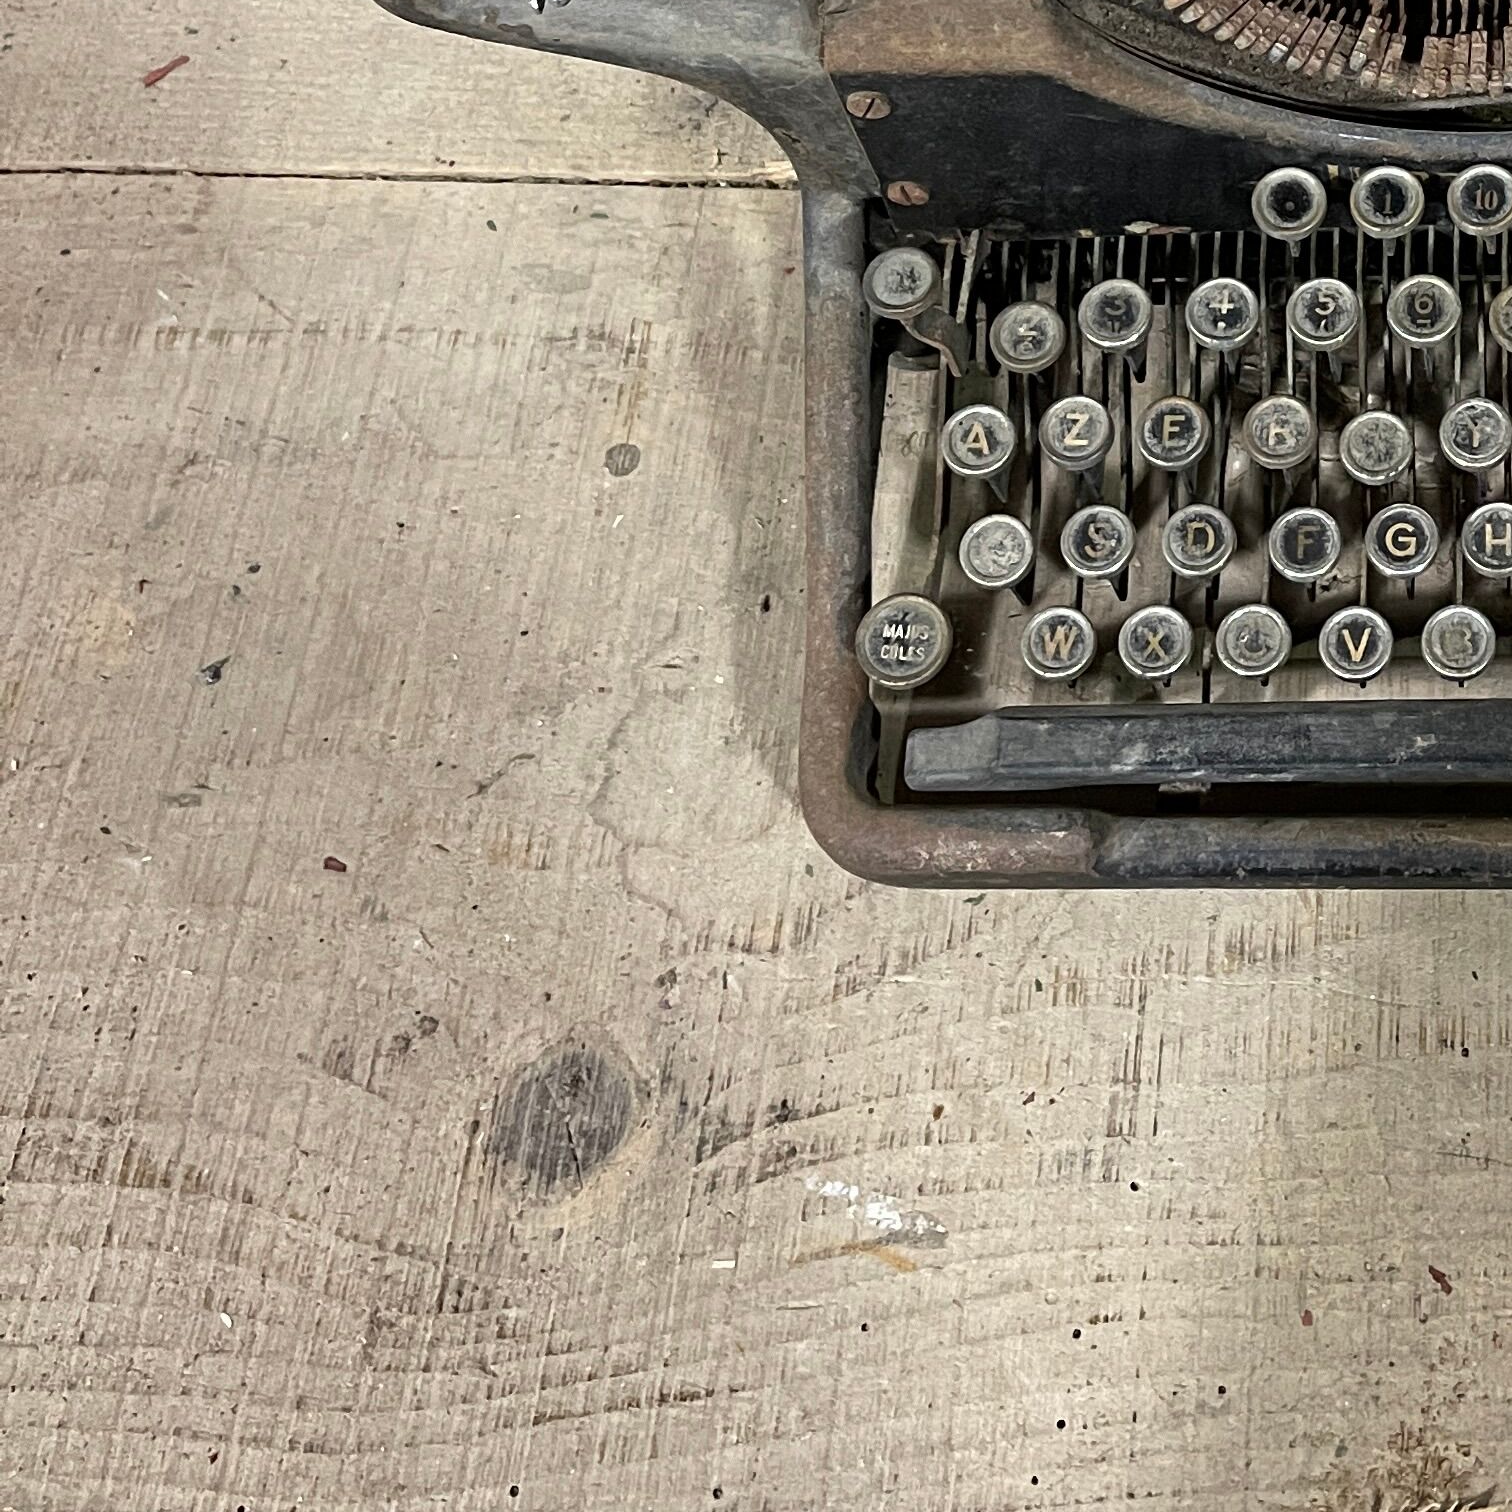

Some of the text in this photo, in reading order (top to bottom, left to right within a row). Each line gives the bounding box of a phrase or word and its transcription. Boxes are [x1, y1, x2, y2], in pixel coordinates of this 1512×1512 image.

[1474, 187, 1499, 210] 10
[965, 421, 990, 455] A
[1063, 412, 1090, 446] Z
[1160, 414, 1186, 447] E
[1083, 518, 1112, 559] S
[1186, 520, 1216, 555] D
[1297, 524, 1321, 560] F
[1385, 522, 1417, 557] G
[1484, 522, 1512, 557] H
[1042, 623, 1079, 661] W
[1143, 630, 1169, 663] X
[1342, 627, 1372, 663] V
